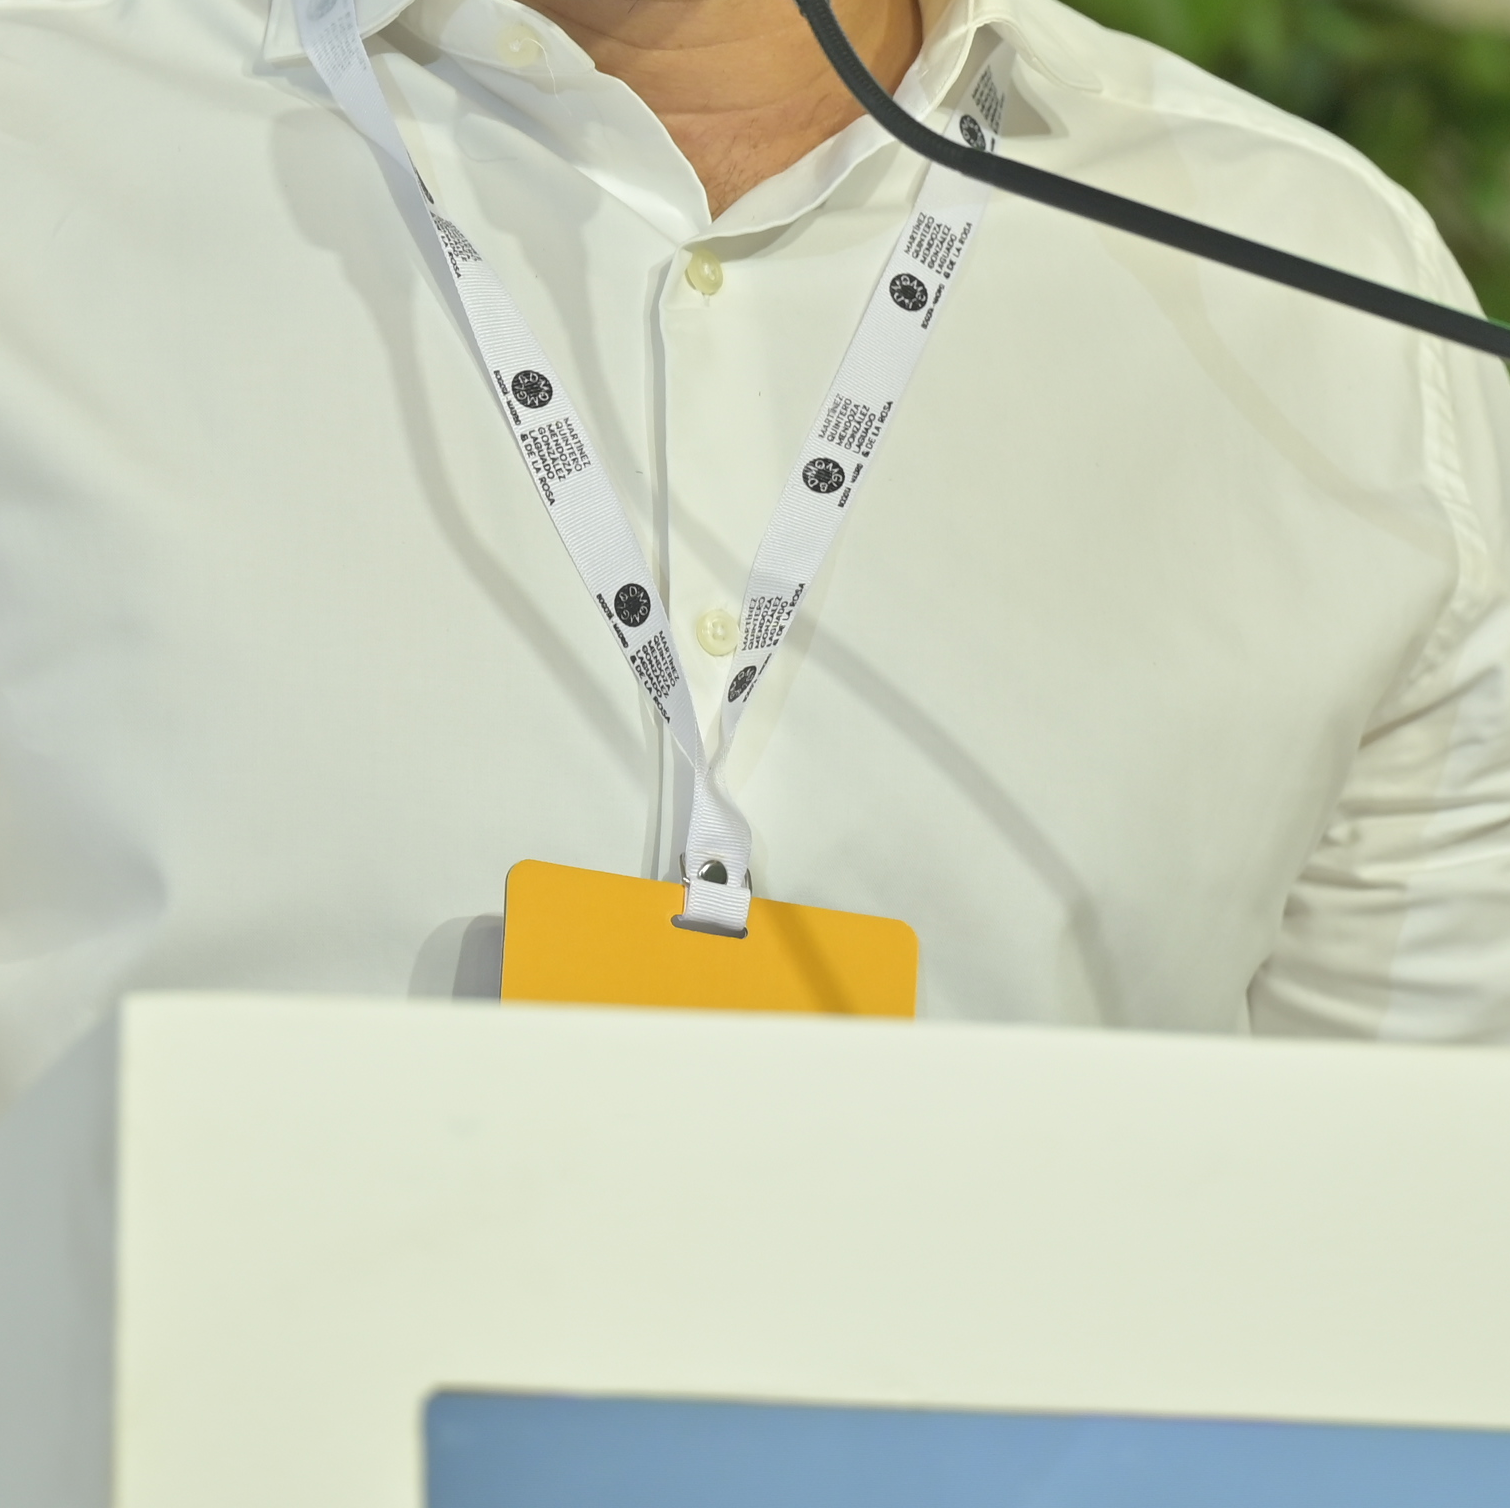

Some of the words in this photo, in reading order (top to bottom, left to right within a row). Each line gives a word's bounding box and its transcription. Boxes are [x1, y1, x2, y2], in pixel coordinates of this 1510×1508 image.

[920, 223, 943, 265] MENDOZA
[935, 233, 958, 275] LAGUADO
[952, 247, 963, 258] LA
[555, 420, 583, 472] QUINTERO
[564, 417, 592, 469] MARTÍNEZ
[827, 398, 852, 443] QUINTERO
[836, 403, 861, 447] MENDOZA
[844, 404, 870, 450] GONZÁLEZ
[852, 413, 876, 454] LAGUADO
[865, 437, 877, 450] DE
[871, 425, 882, 437] LA
[877, 401, 894, 424] ROSA
[524, 443, 536, 459] DE
[531, 460, 542, 475] LA
[538, 476, 556, 506] ROSA
[528, 430, 555, 480] LAGUADO
[538, 427, 567, 482] GONZÁLEZ
[546, 423, 575, 476] MENDOZA
[741, 597, 758, 651] MARTÍNEZ
[748, 596, 766, 650] QUINTERO
[755, 597, 774, 649] MENDOZA
[761, 596, 783, 648] GONZÁLEZ
[766, 601, 788, 648] LAGUADO
[776, 625, 786, 636] DE
[782, 609, 793, 621] LA
[789, 583, 806, 608] ROSA
[635, 649, 663, 699] LAGUADO
[641, 645, 670, 699] GONZÁLEZ
[647, 639, 671, 693] MENDOZA
[653, 635, 676, 688] QUINTERO
[659, 630, 680, 683] MARTÍNEZ
[635, 664, 646, 680] DE
[644, 680, 652, 695] LA
[653, 696, 671, 724] ROSA
